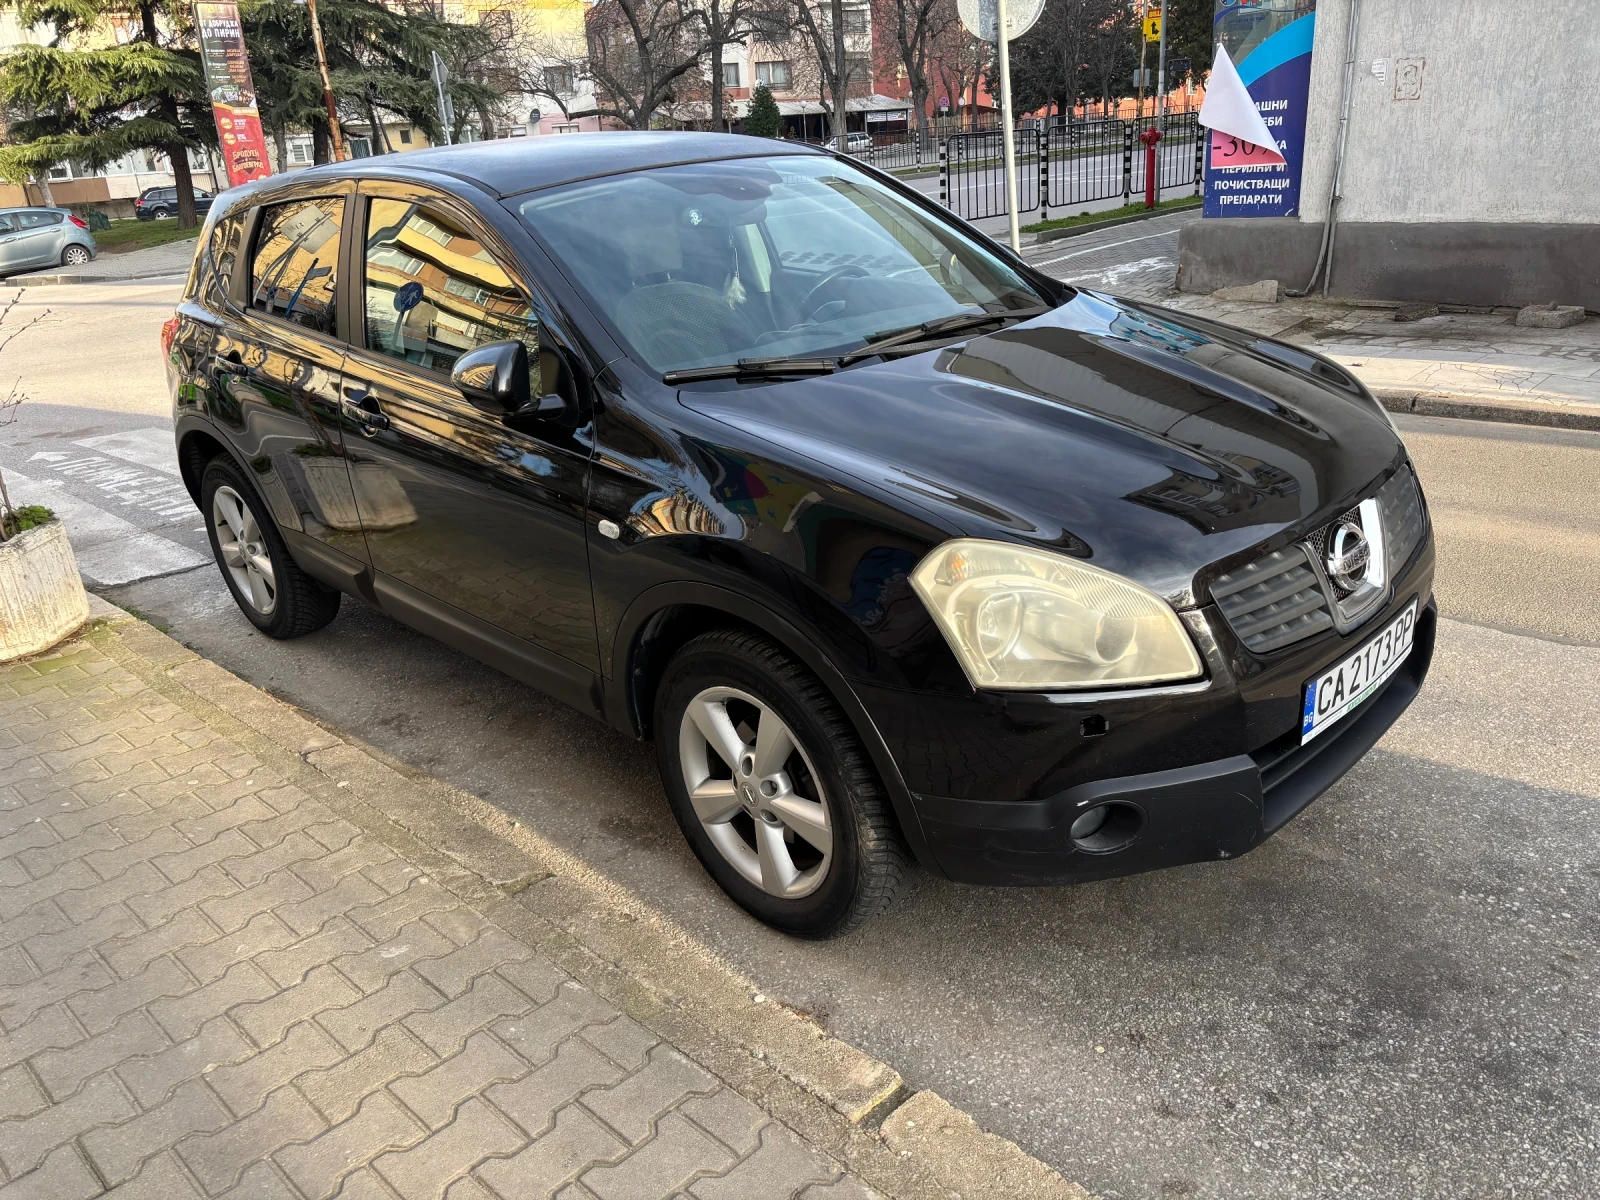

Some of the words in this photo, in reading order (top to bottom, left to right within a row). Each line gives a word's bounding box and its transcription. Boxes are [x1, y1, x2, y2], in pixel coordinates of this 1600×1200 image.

[199, 19, 207, 27] ОТ
[208, 19, 239, 28] ДОБРУДЖА
[201, 28, 212, 39] ДО
[213, 28, 240, 38] ПИРИН
[1255, 99, 1288, 111] АШНИ
[1212, 136, 1268, 157] -30
[232, 147, 260, 161] БРОДУЕЙ
[1214, 178, 1290, 190] ПОЧИСТВАЩИ
[1219, 194, 1282, 205] ПРЕПАРАТИ
[1303, 711, 1313, 727] BG
